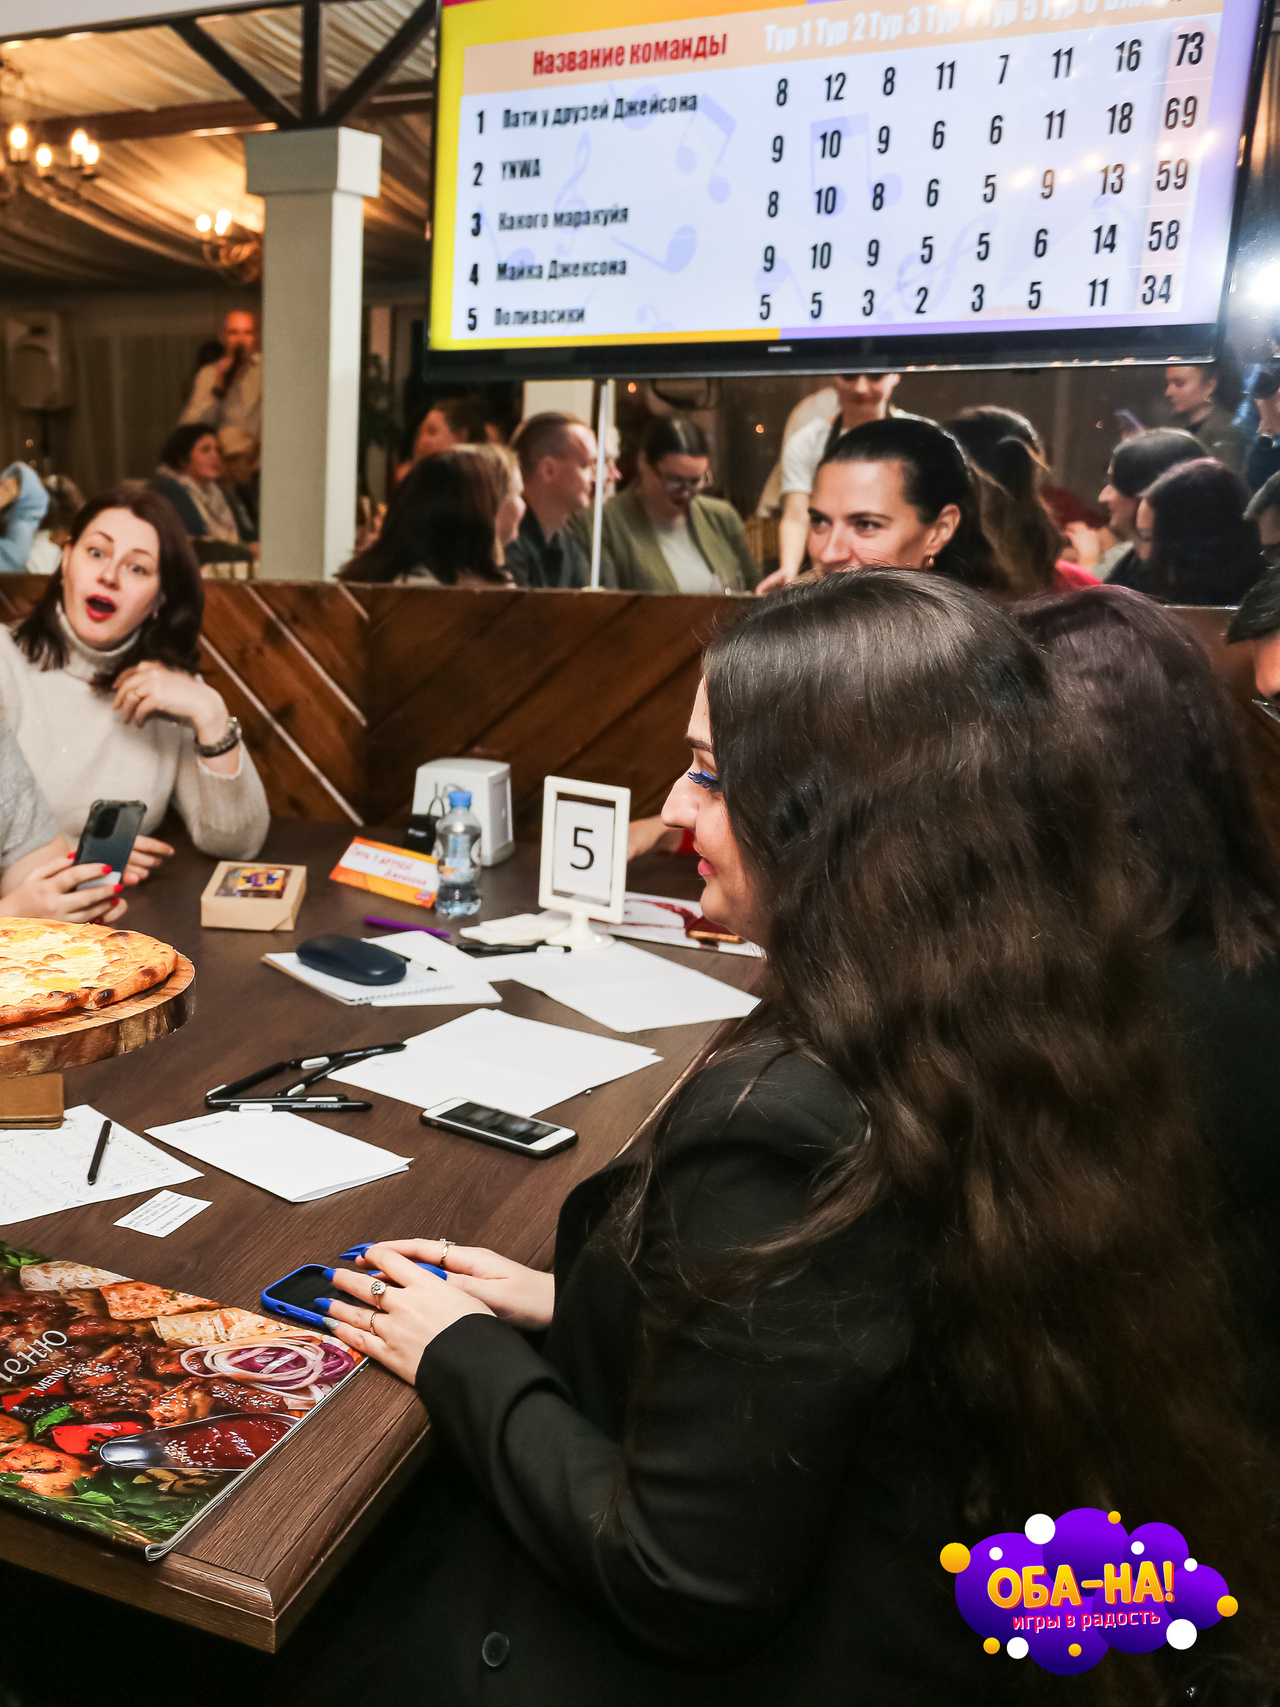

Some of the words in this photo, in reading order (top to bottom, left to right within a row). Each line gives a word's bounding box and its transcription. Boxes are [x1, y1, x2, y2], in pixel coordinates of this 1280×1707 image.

[532, 44, 625, 76] Название
[629, 33, 728, 65] команды
[764, 24, 798, 53] Тур
[801, 20, 812, 47] 1
[815, 18, 849, 47] Тур
[852, 13, 866, 41] 2
[870, 11, 903, 41] Тур
[907, 6, 920, 35] 3
[925, 4, 960, 34] Тур
[477, 111, 485, 134] 1
[542, 108, 550, 128] у
[613, 95, 697, 119] Джейсона
[776, 78, 789, 106] 8
[824, 72, 847, 101] 12
[882, 67, 896, 96] 8
[936, 61, 956, 90] 11
[998, 55, 1010, 84] 7
[1052, 47, 1074, 78] 11
[1115, 39, 1143, 71] 16
[1175, 32, 1205, 66] 73
[472, 162, 484, 186] 2
[771, 135, 784, 163] 9
[819, 130, 842, 158] 10
[877, 126, 891, 154] 9
[932, 121, 946, 149] 6
[989, 115, 1004, 144] 6
[1045, 110, 1066, 139] 11
[1107, 102, 1134, 134] 18
[1164, 96, 1198, 130] 69
[471, 213, 482, 237] 3
[499, 213, 548, 230] Какого
[553, 204, 629, 227] маракуйя
[767, 191, 780, 218] 8
[815, 186, 837, 214] 10
[871, 183, 885, 211] 8
[926, 179, 940, 207] 6
[982, 175, 997, 203] 5
[1040, 170, 1055, 199] 9
[1101, 164, 1125, 195] 13
[1156, 159, 1189, 191] 59
[469, 264, 479, 285] 4
[548, 260, 626, 279] Джексона
[763, 246, 776, 272] 9
[810, 242, 832, 269] 10
[866, 239, 880, 267] 9
[920, 236, 934, 264] 5
[976, 233, 991, 261] 5
[1033, 229, 1049, 258] 6
[1093, 224, 1118, 254] 14
[1148, 220, 1180, 251] 58
[467, 308, 478, 331] 5
[759, 294, 771, 320] 5
[810, 292, 823, 319] 5
[862, 289, 875, 316] 3
[914, 287, 929, 314] 2
[971, 284, 985, 312] 3
[1027, 282, 1042, 310] 5
[1088, 279, 1109, 306] 11
[1141, 275, 1173, 305] 34
[570, 827, 595, 870] 5
[32, 1366, 71, 1392] MENU
